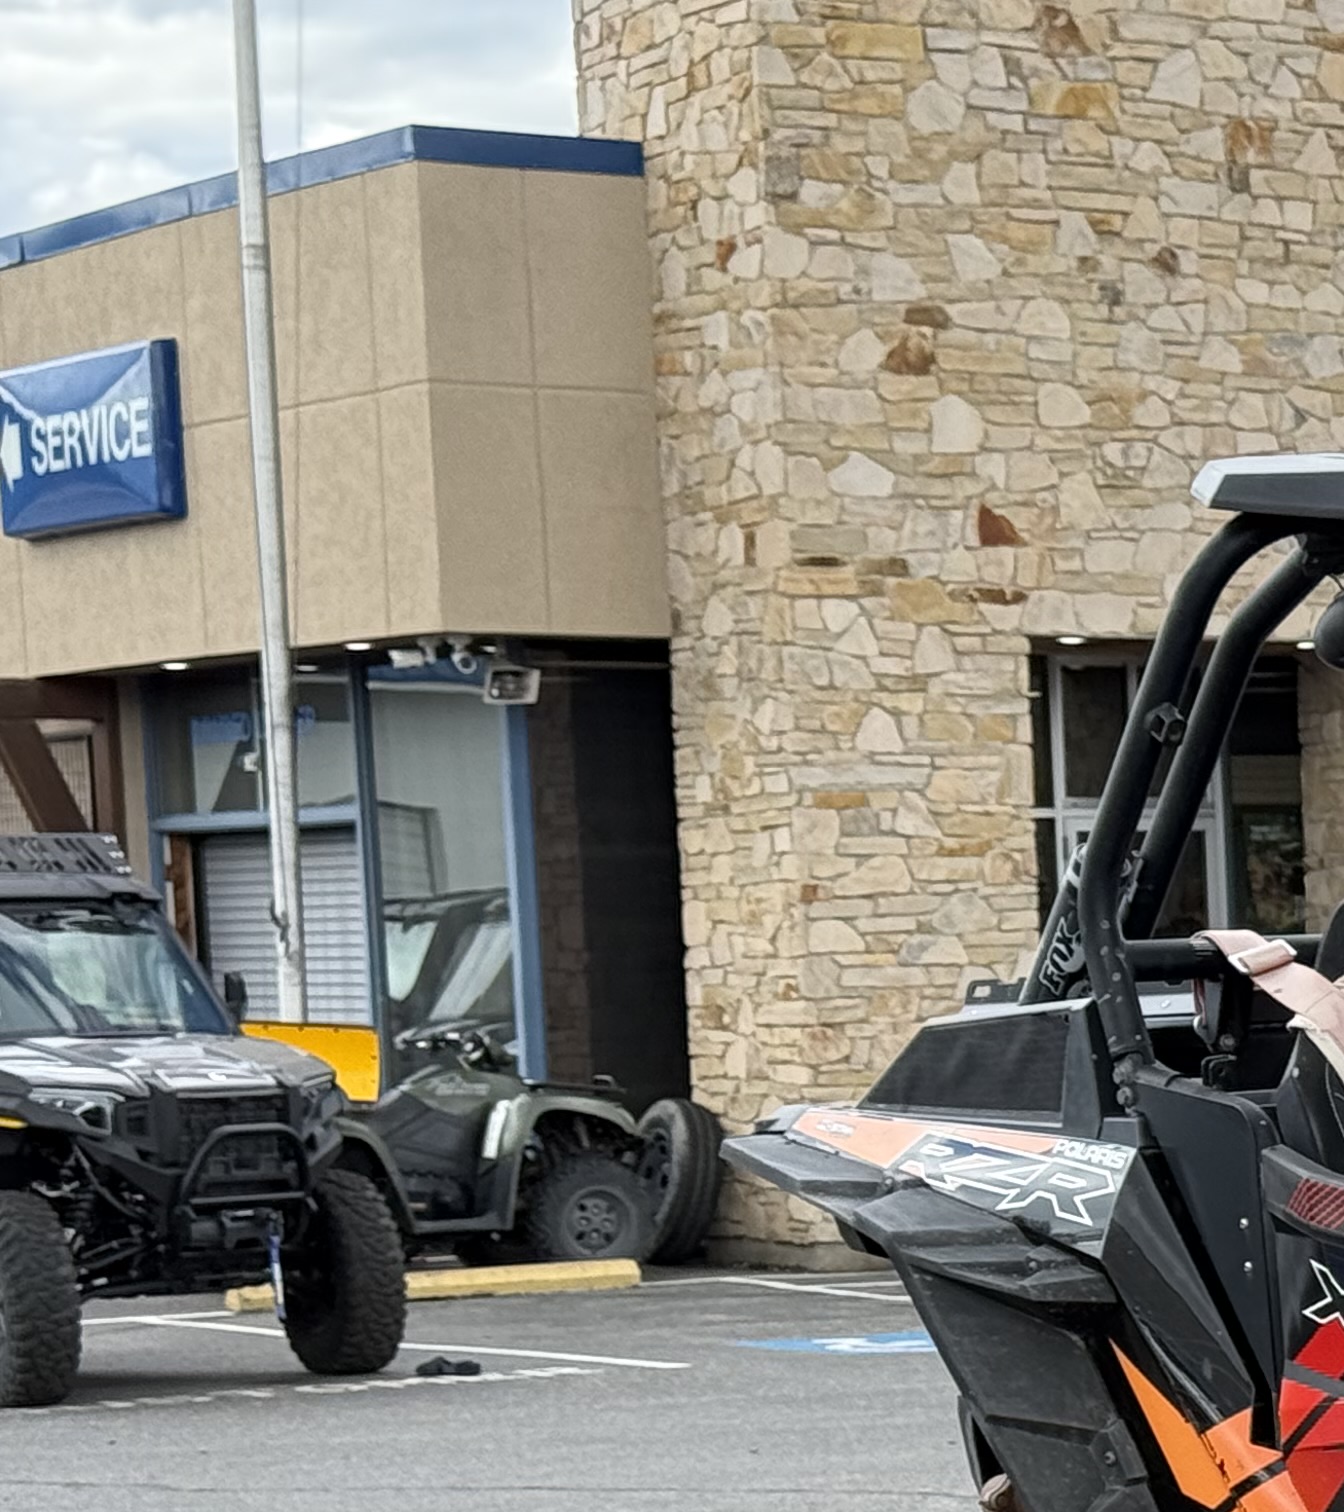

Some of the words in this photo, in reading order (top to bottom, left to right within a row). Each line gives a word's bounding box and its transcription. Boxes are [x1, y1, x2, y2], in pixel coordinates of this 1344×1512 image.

[31, 397, 152, 477] SERVICE
[1039, 916, 1082, 996] FOX
[898, 1132, 1117, 1227] RZR
[1052, 1139, 1128, 1169] POLARIS
